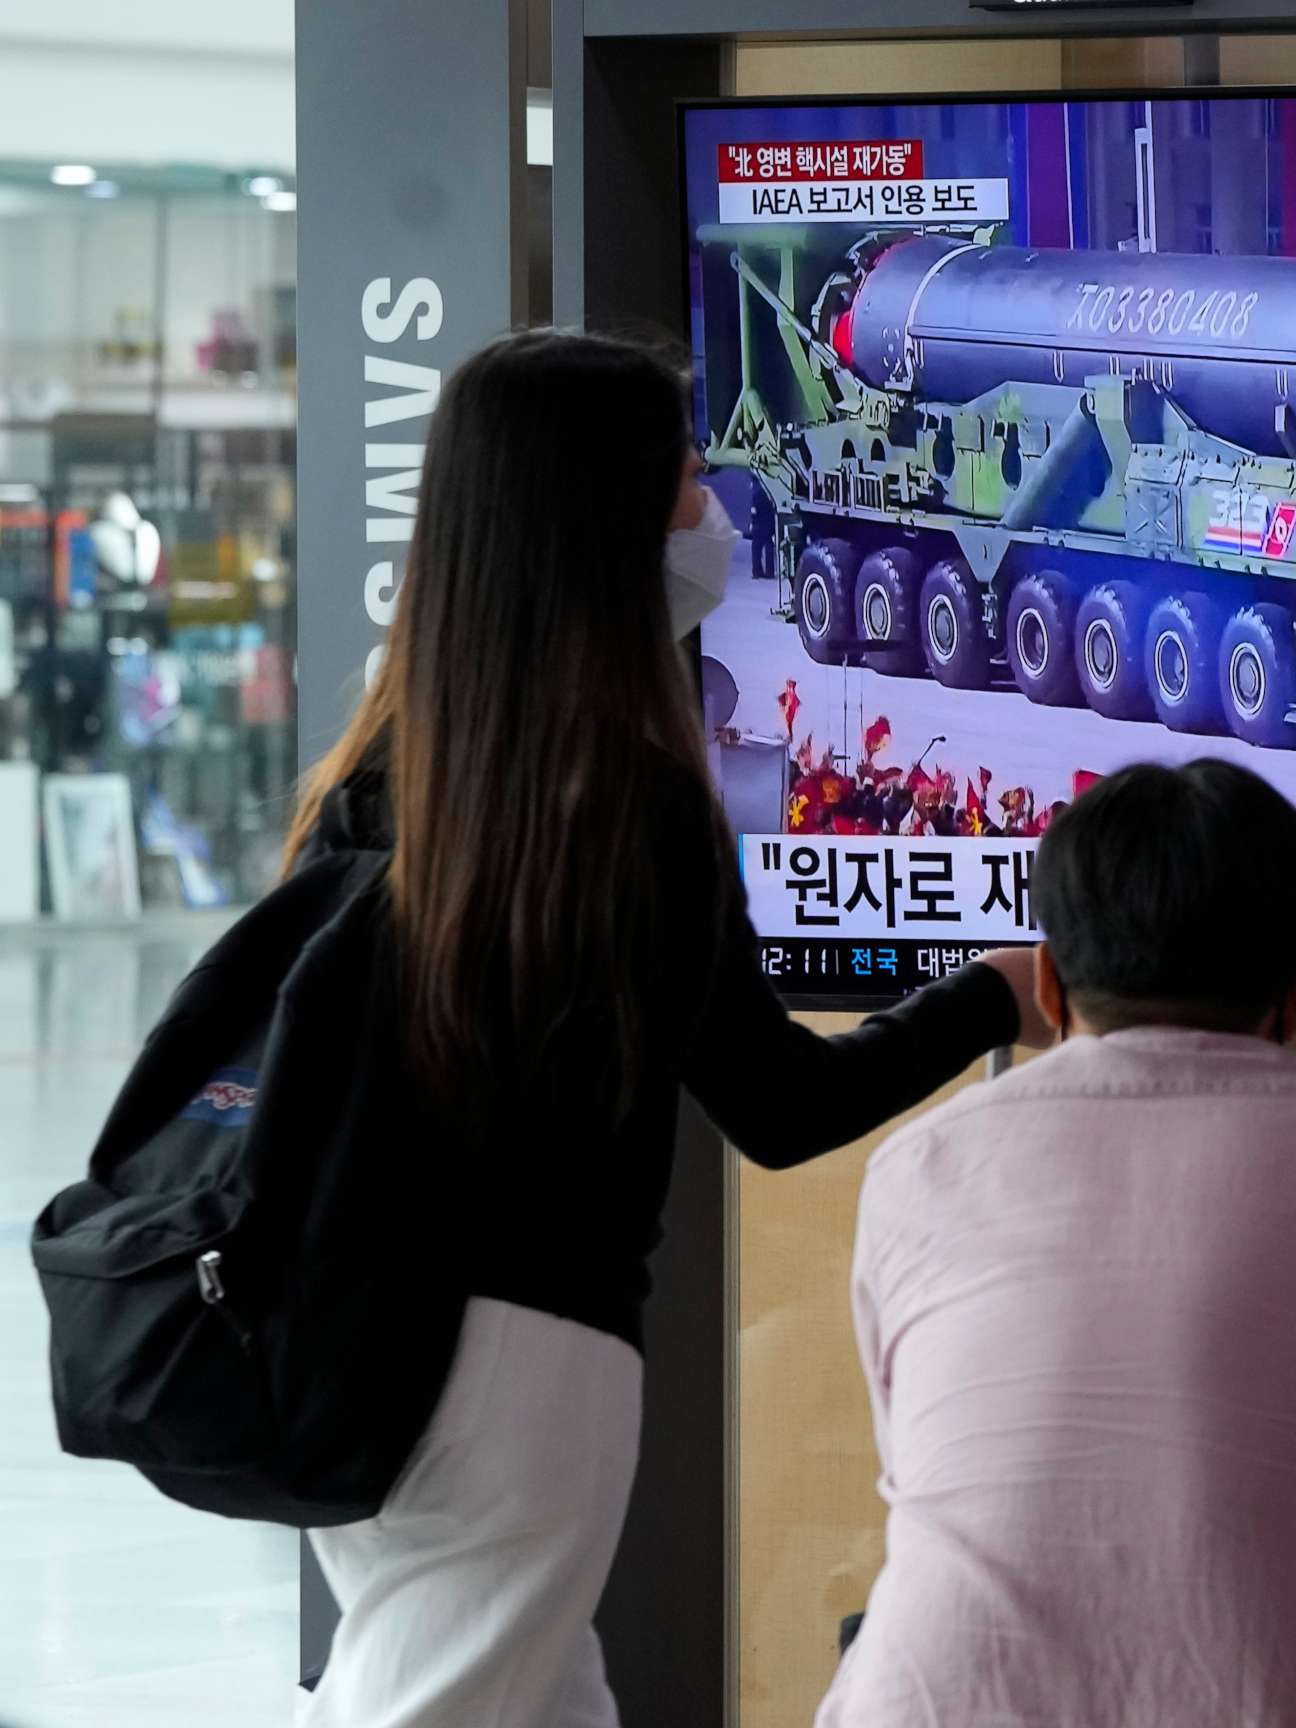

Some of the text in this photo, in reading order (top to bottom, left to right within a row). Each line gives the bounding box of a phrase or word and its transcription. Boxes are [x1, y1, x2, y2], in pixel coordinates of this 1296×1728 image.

[757, 146, 792, 178] 영변
[796, 145, 849, 177] 핵시설
[853, 143, 912, 176] 재가동"
[752, 185, 978, 215] IAEA 보고서 인용 보도
[761, 843, 962, 929] "원자로
[851, 947, 898, 976] 전국
